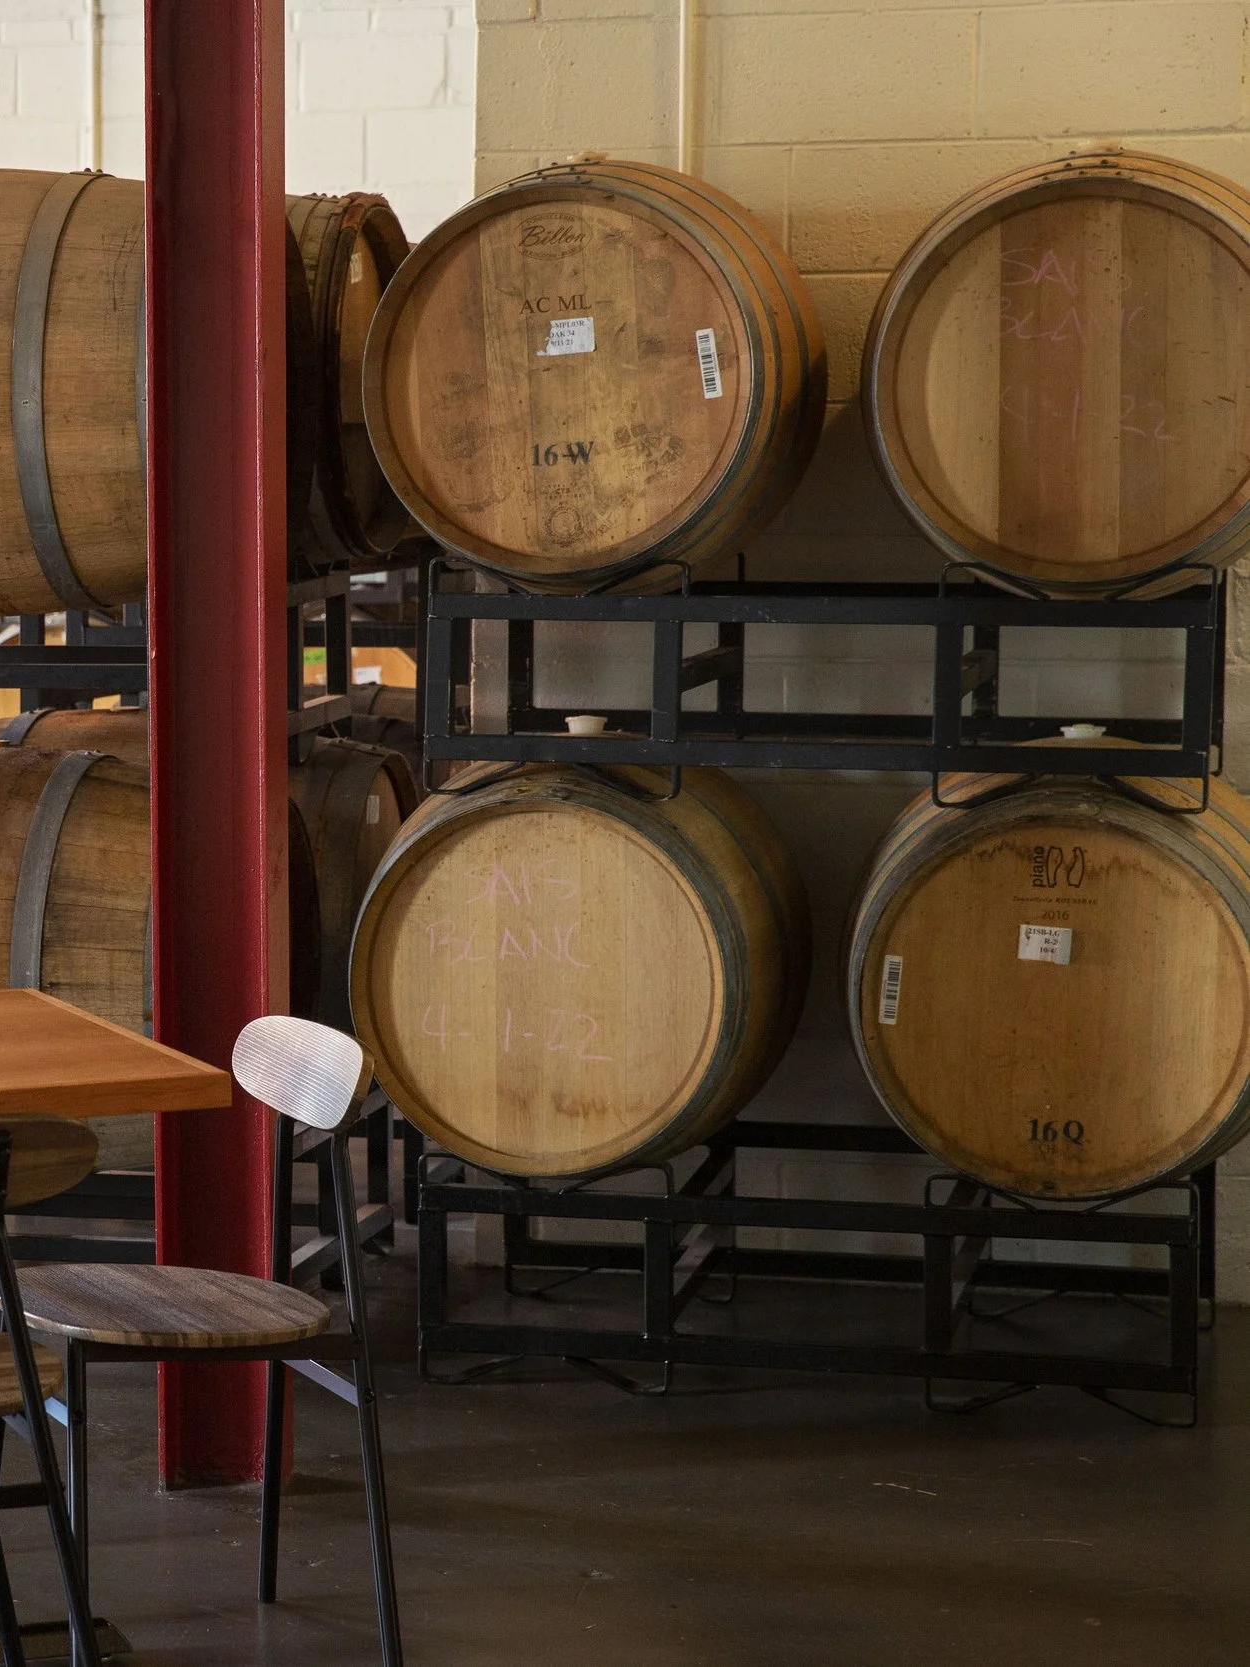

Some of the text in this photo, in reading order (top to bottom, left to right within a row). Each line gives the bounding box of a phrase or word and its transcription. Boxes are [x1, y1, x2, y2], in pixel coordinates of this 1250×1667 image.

[518, 225, 586, 247] Billon
[520, 294, 592, 315] AC ML
[1031, 845, 1047, 888] piano
[1041, 910, 1070, 920] 2016
